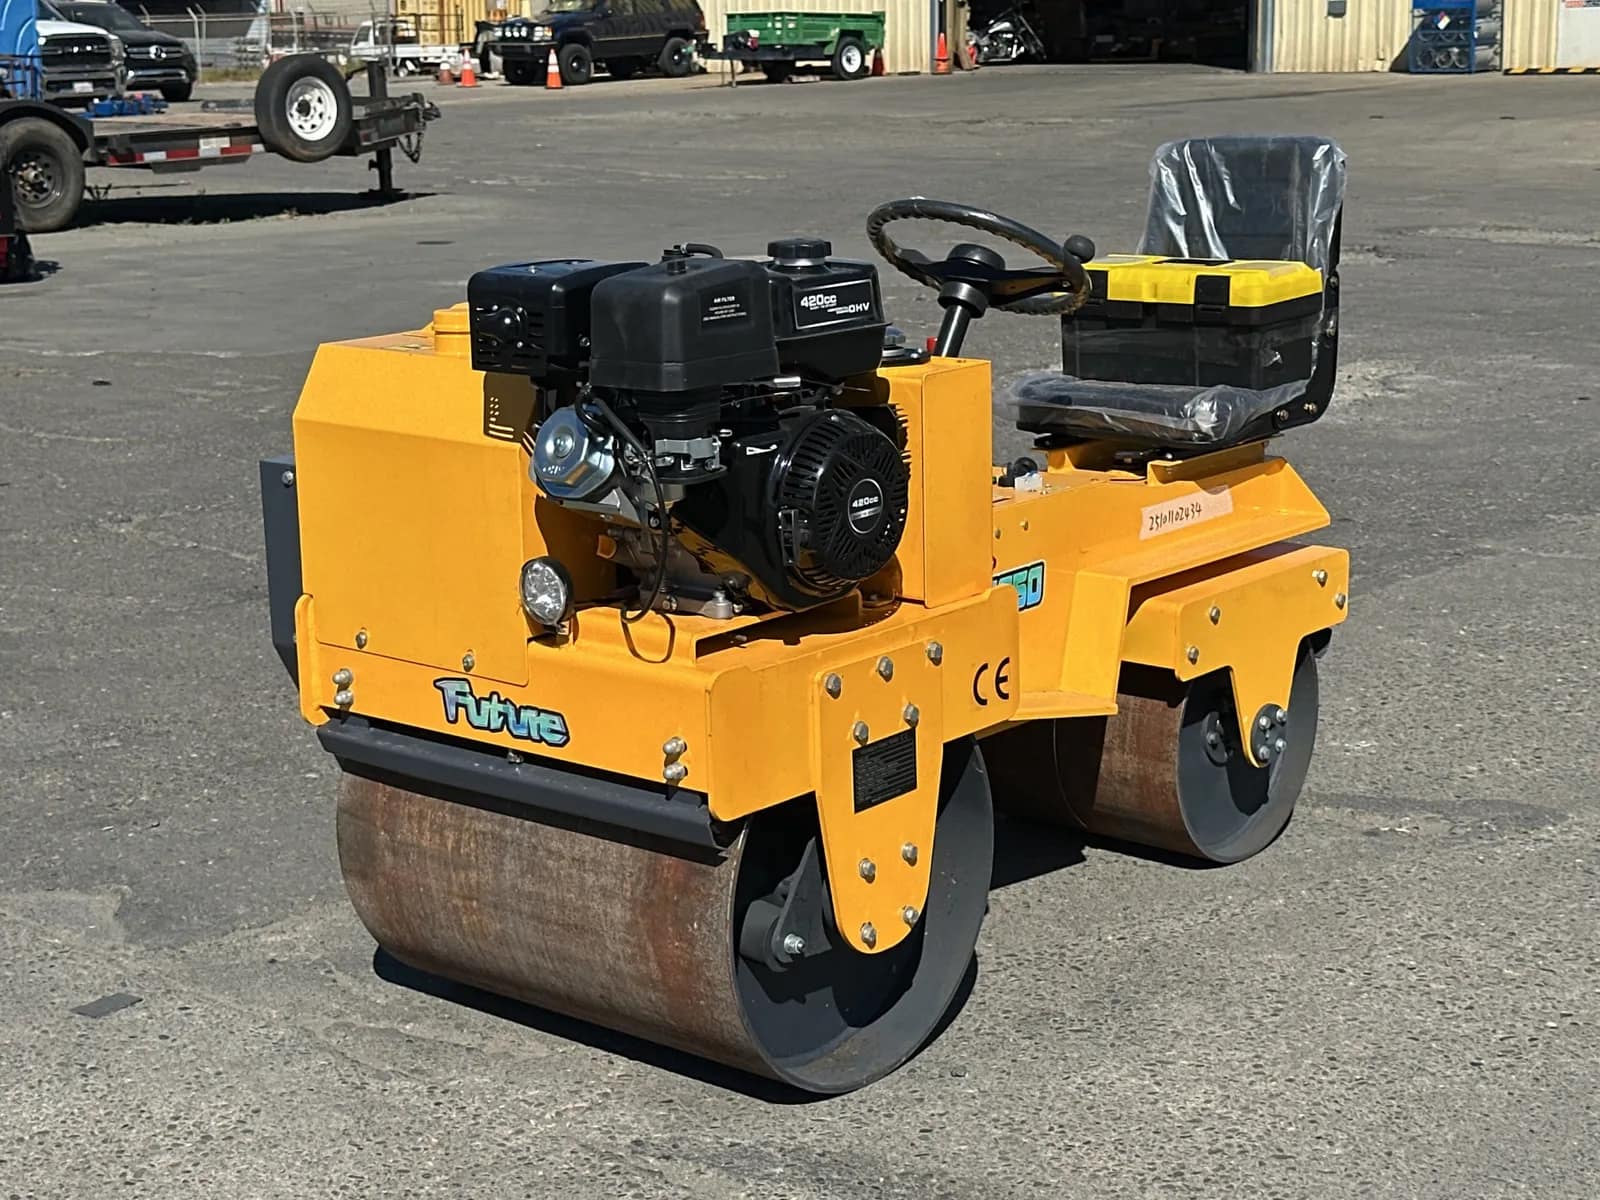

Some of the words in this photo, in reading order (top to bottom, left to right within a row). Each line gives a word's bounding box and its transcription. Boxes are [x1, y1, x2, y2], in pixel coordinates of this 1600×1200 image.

[800, 293, 836, 307] 420cc
[848, 301, 870, 313] OHV
[852, 495, 879, 508] 420cc
[973, 656, 1010, 706] CE
[433, 677, 570, 748] Future
